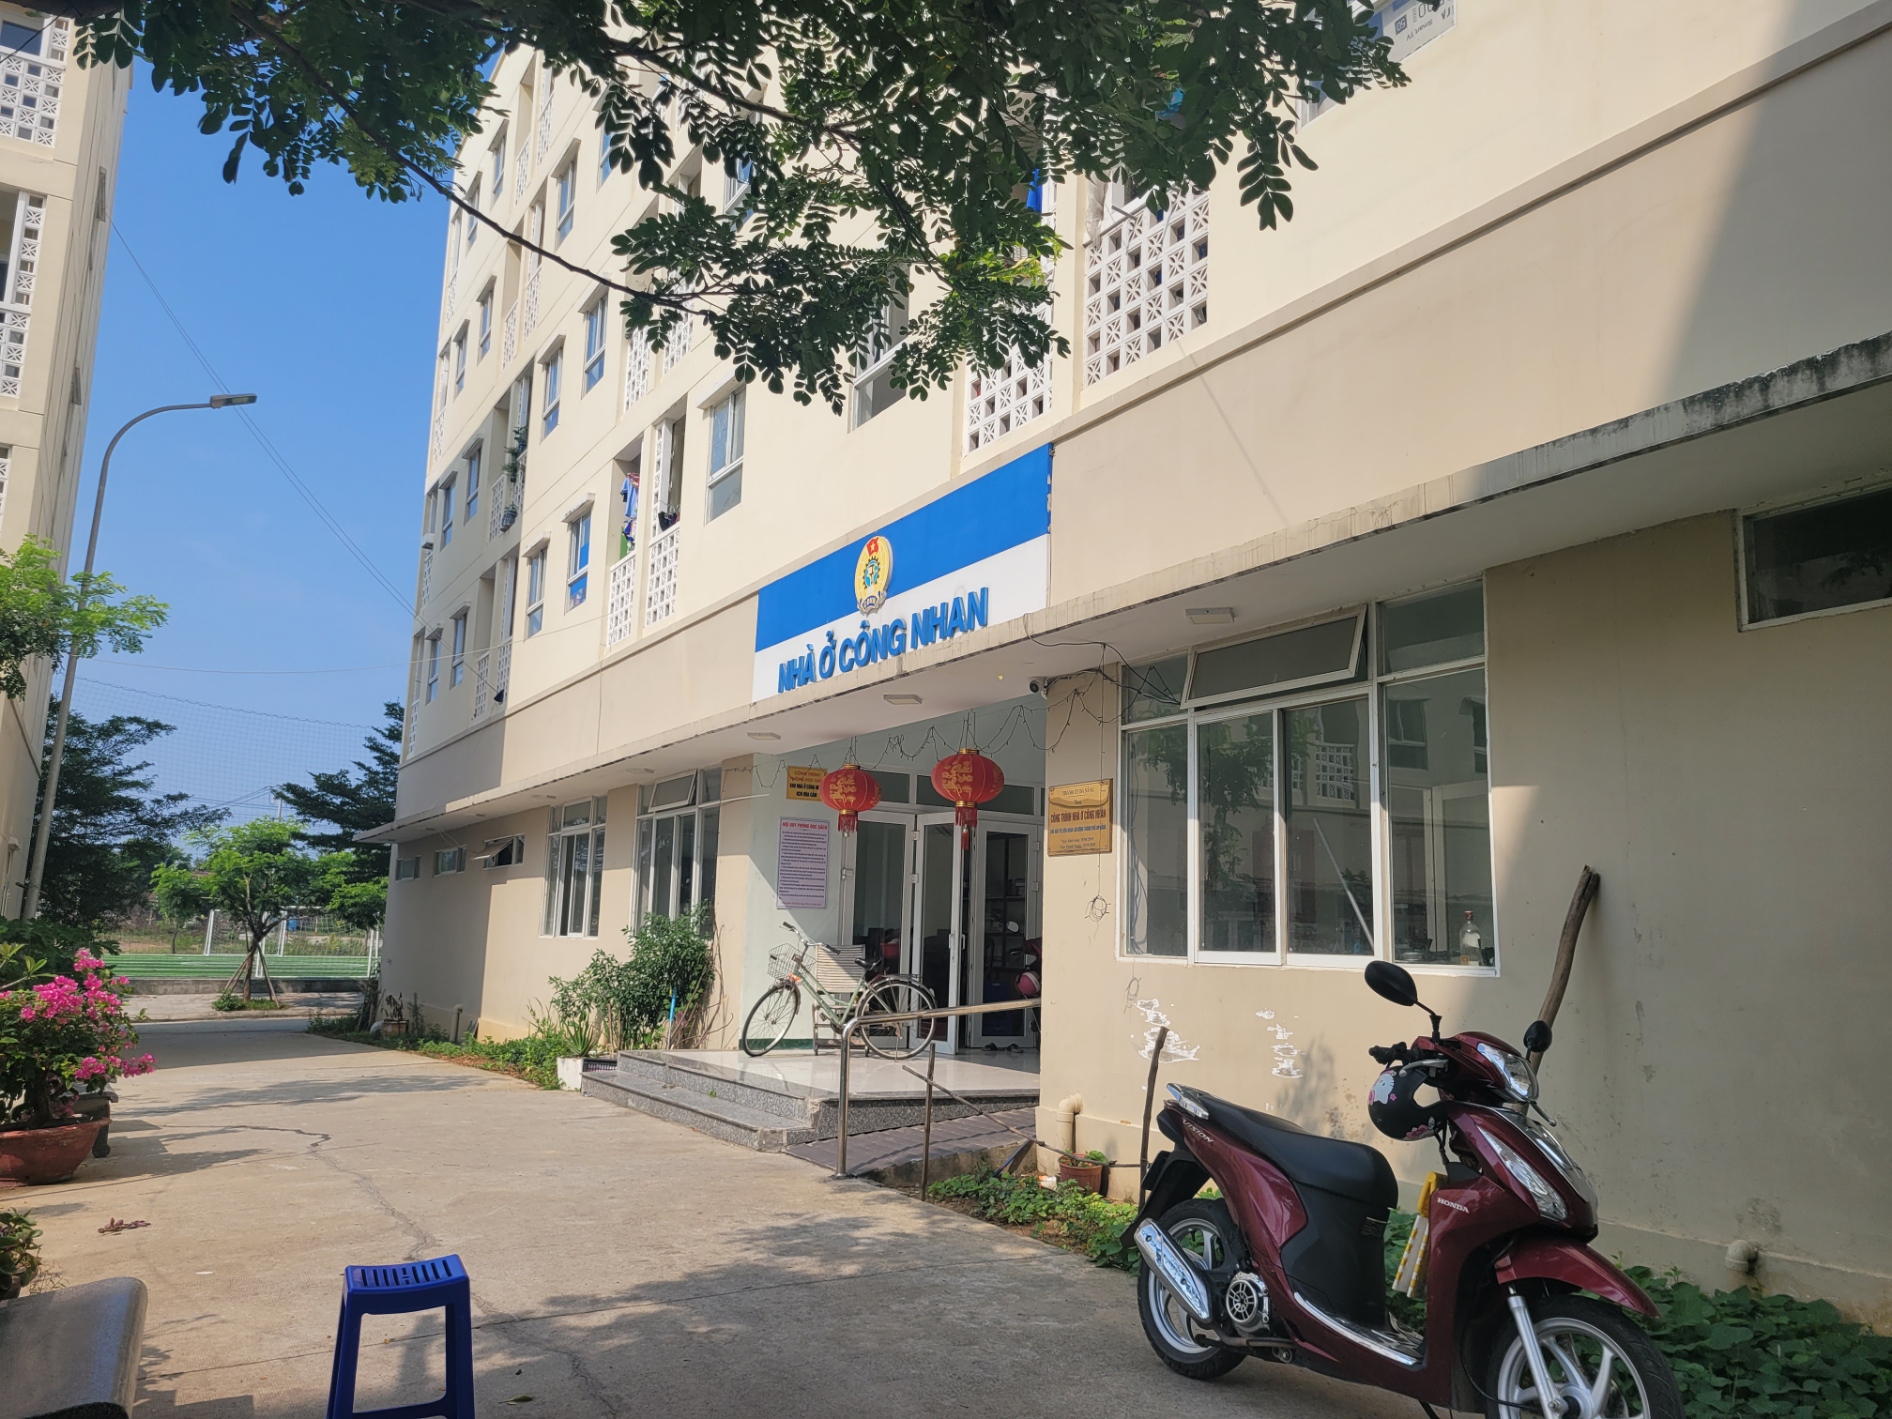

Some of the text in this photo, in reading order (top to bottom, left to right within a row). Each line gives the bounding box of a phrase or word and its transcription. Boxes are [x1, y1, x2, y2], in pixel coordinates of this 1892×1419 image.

[1396, 18, 1406, 32] 50
[1406, 19, 1433, 41] Smart TV
[777, 643, 817, 694] NHÀ
[818, 629, 837, 679] Ở
[838, 618, 907, 673] CÔNG
[1182, 1118, 1214, 1143] VISION
[1437, 1197, 1469, 1214] HONDA
